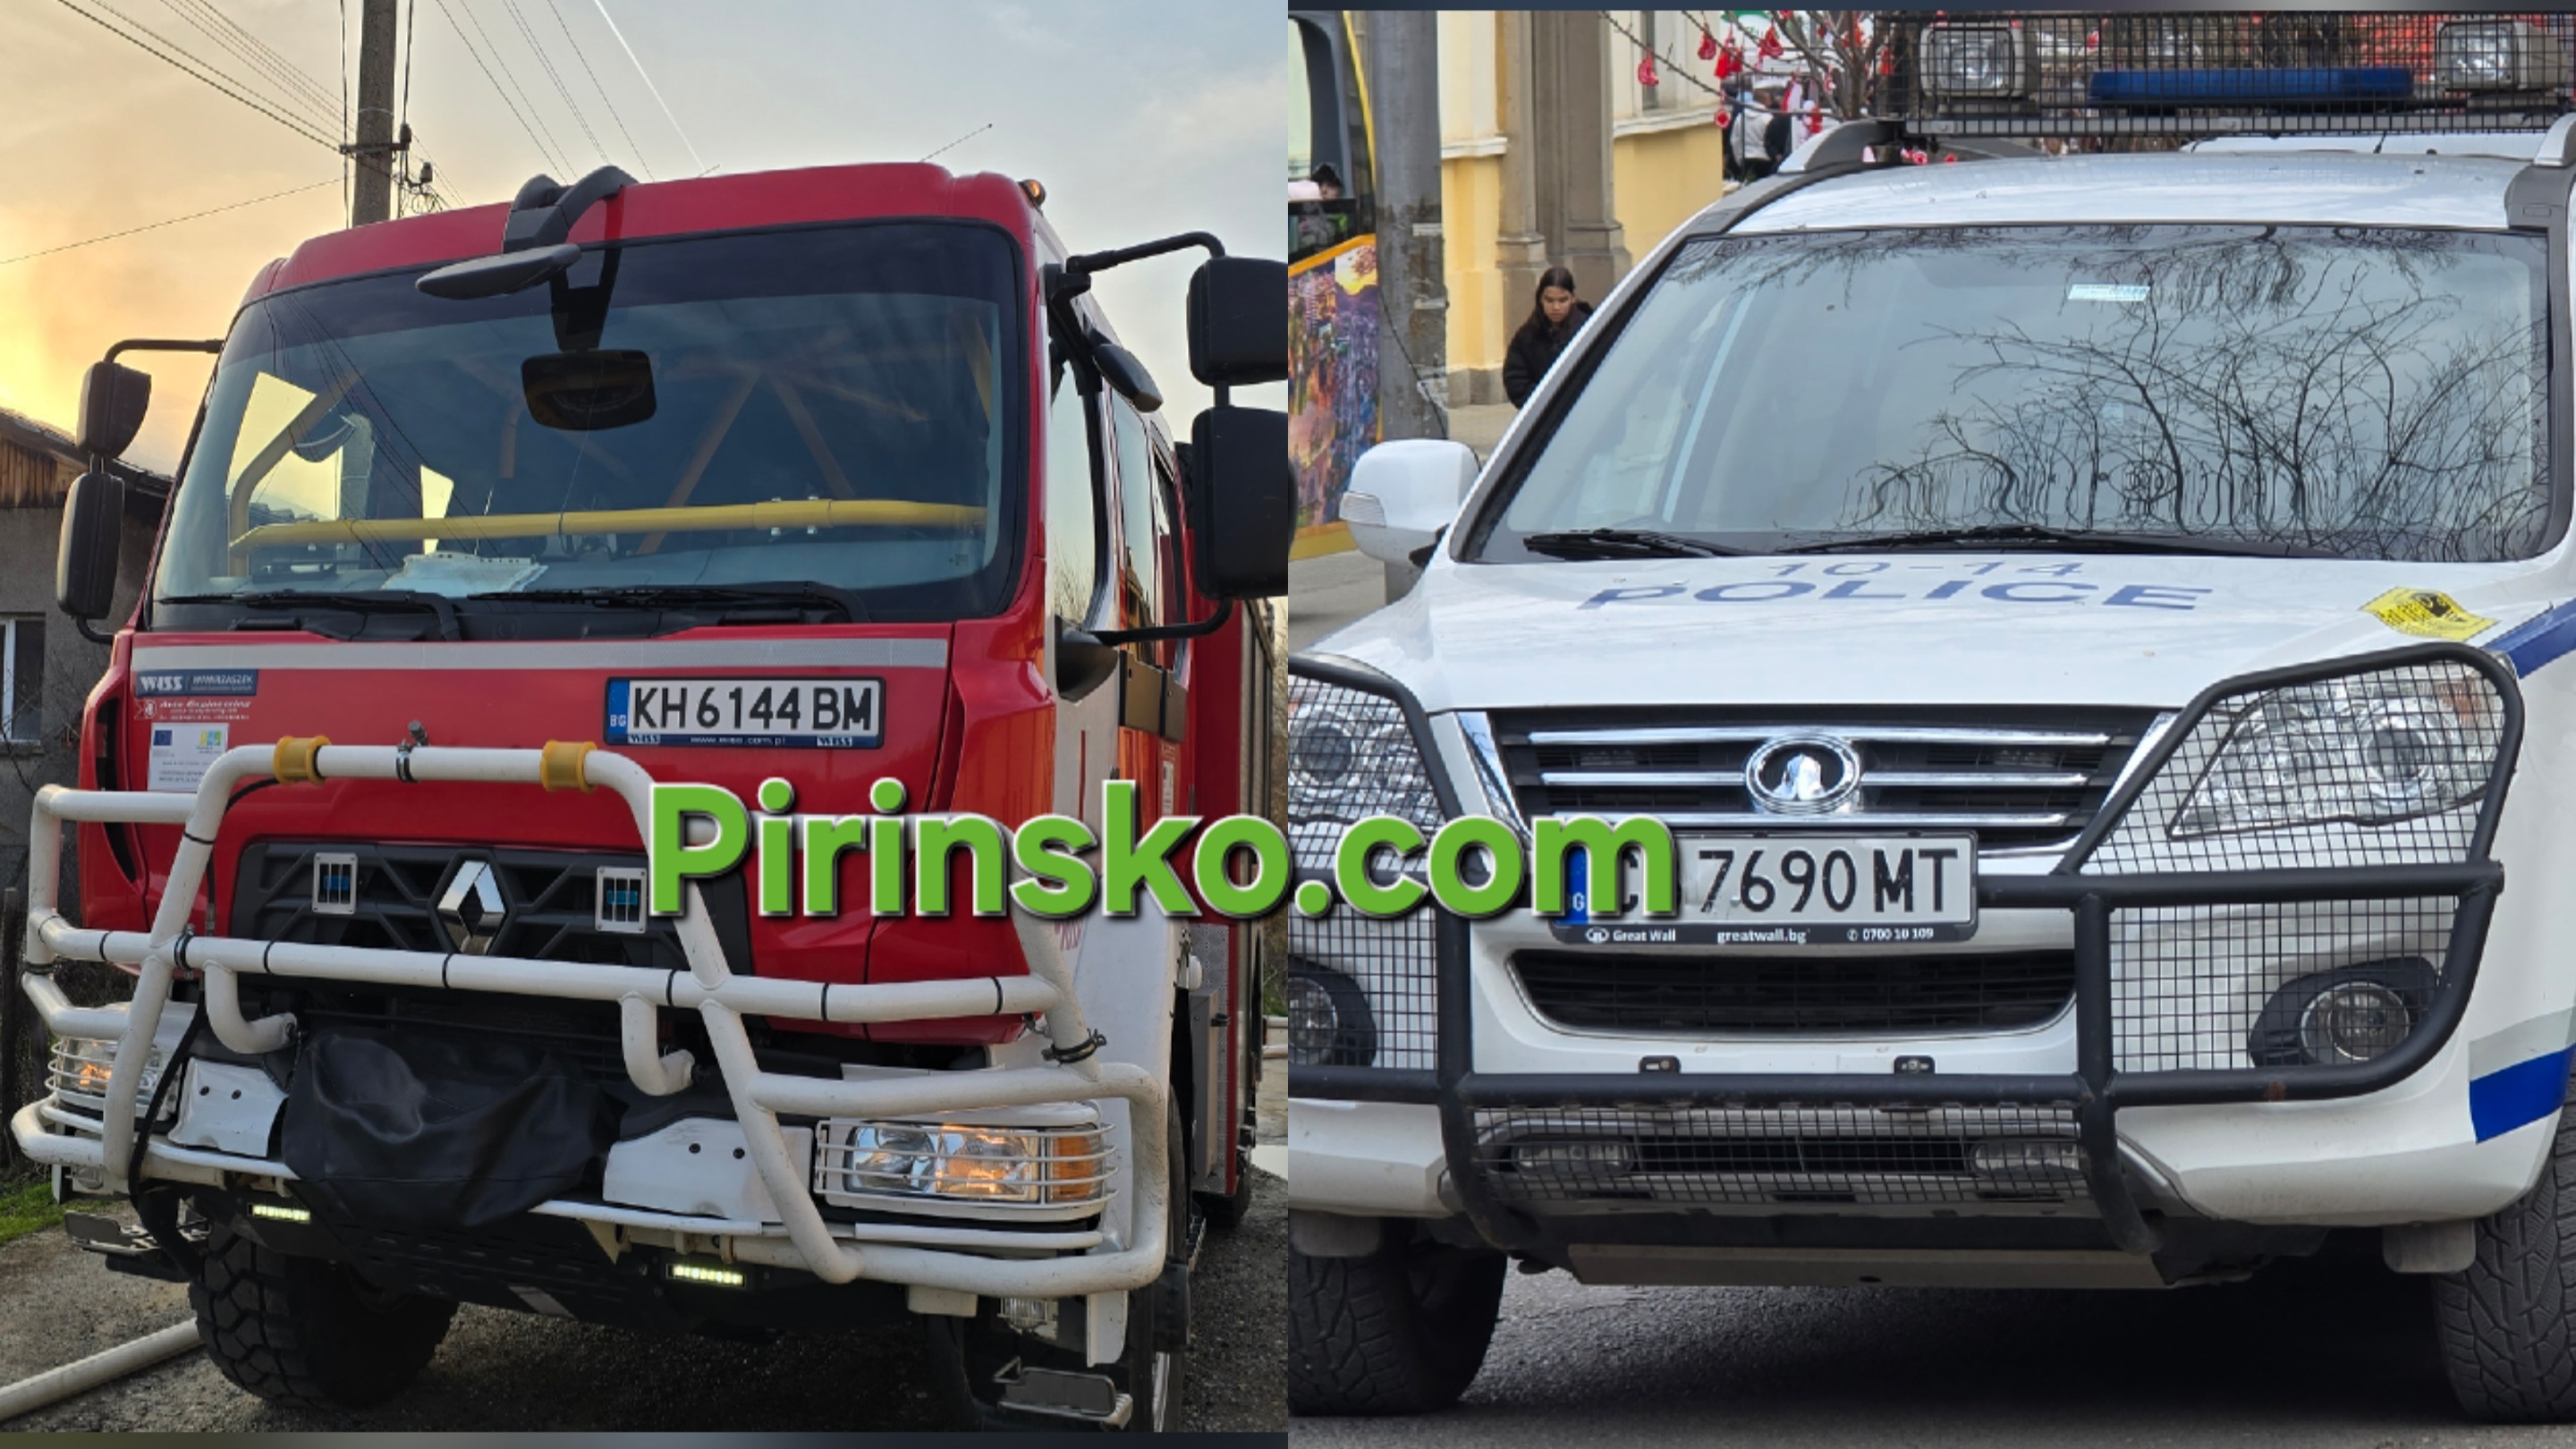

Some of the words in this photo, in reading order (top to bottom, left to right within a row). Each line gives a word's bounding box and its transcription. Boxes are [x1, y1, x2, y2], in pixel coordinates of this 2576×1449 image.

[1577, 580, 2214, 611] POLICE
[140, 675, 182, 691] WISS
[609, 715, 627, 727] BG
[1698, 848, 1858, 913] 7690
[1872, 848, 1959, 913] MT
[1613, 929, 1647, 942] Great
[1649, 928, 1676, 942] Wall
[1717, 928, 1807, 945] greatwall.bg
[1862, 928, 1893, 941] 0700
[1894, 928, 1910, 940] 10
[1911, 927, 1935, 939] 109
